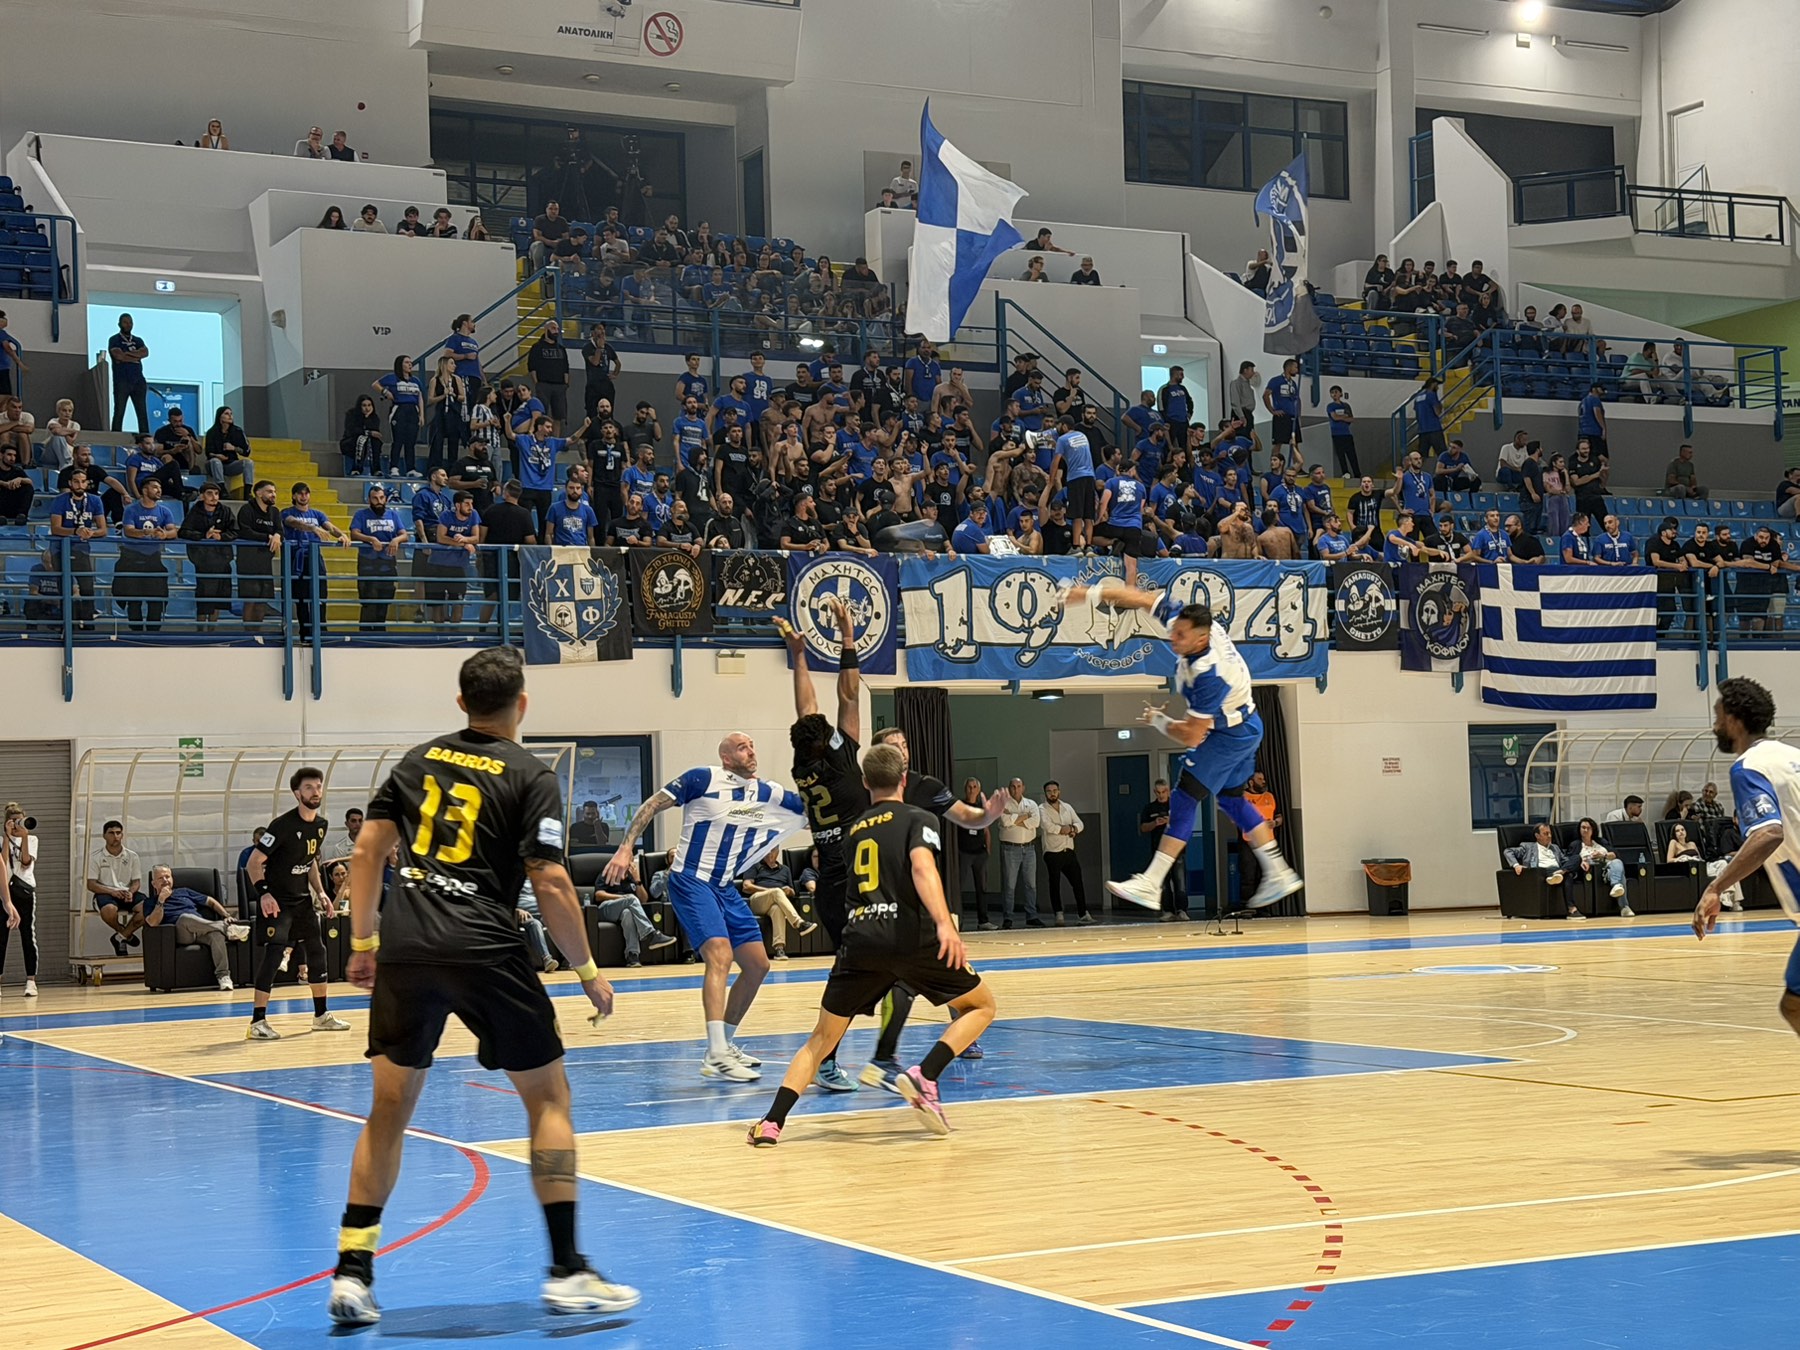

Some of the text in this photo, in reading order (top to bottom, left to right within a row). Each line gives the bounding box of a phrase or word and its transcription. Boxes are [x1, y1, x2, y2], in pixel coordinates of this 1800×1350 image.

[557, 26, 613, 39] ΑΝΑΤΟΛΙΚΗ
[372, 326, 391, 336] VIP
[755, 379, 767, 390] 19
[754, 388, 767, 400] 94
[582, 605, 601, 625] Φ
[646, 608, 697, 620] FAMAGUSTA
[658, 619, 690, 630] GHETTO
[1349, 626, 1382, 640] GHETTO
[424, 746, 506, 776] BARROS
[411, 774, 483, 864] 13
[306, 838, 317, 855] 18
[854, 837, 879, 894] 9
